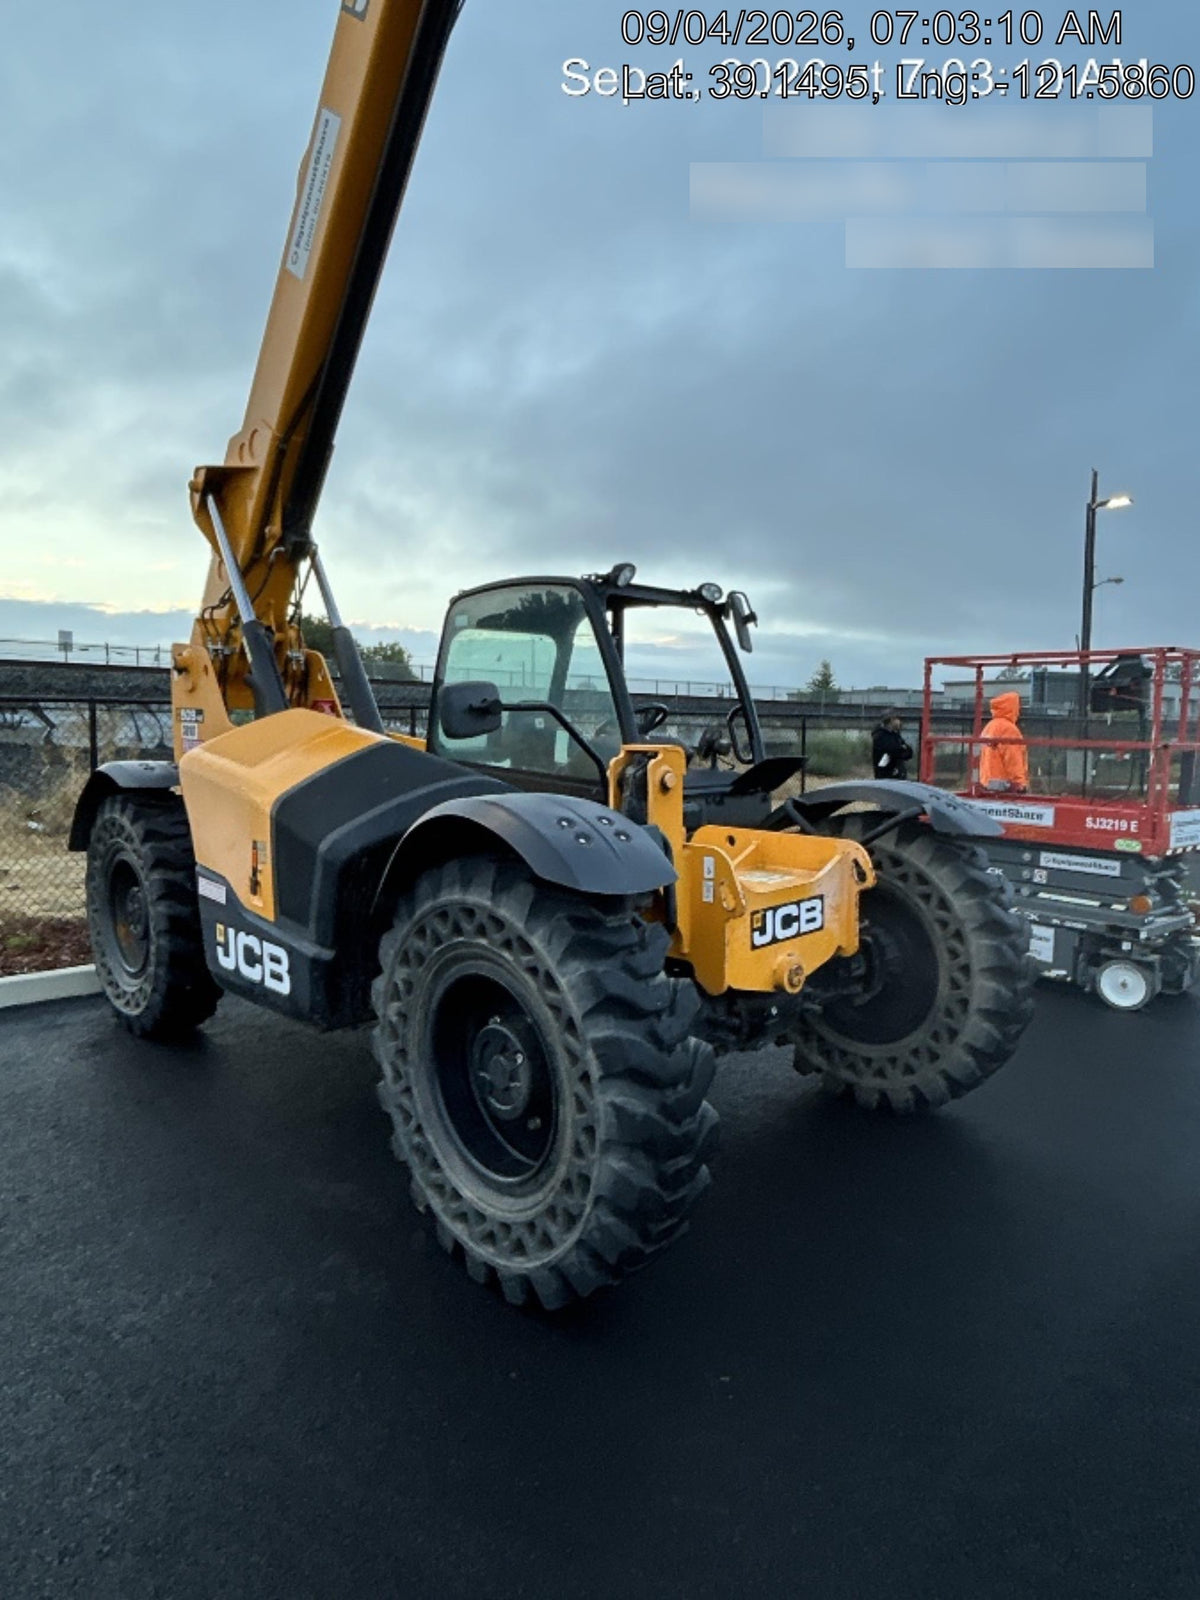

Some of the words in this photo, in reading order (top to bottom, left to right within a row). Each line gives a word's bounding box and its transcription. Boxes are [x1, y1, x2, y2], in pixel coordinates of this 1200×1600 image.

[1085, 817, 1128, 832] SJ3219
[1129, 820, 1139, 833] E
[752, 897, 823, 948] JCB
[216, 924, 291, 996] JCB
